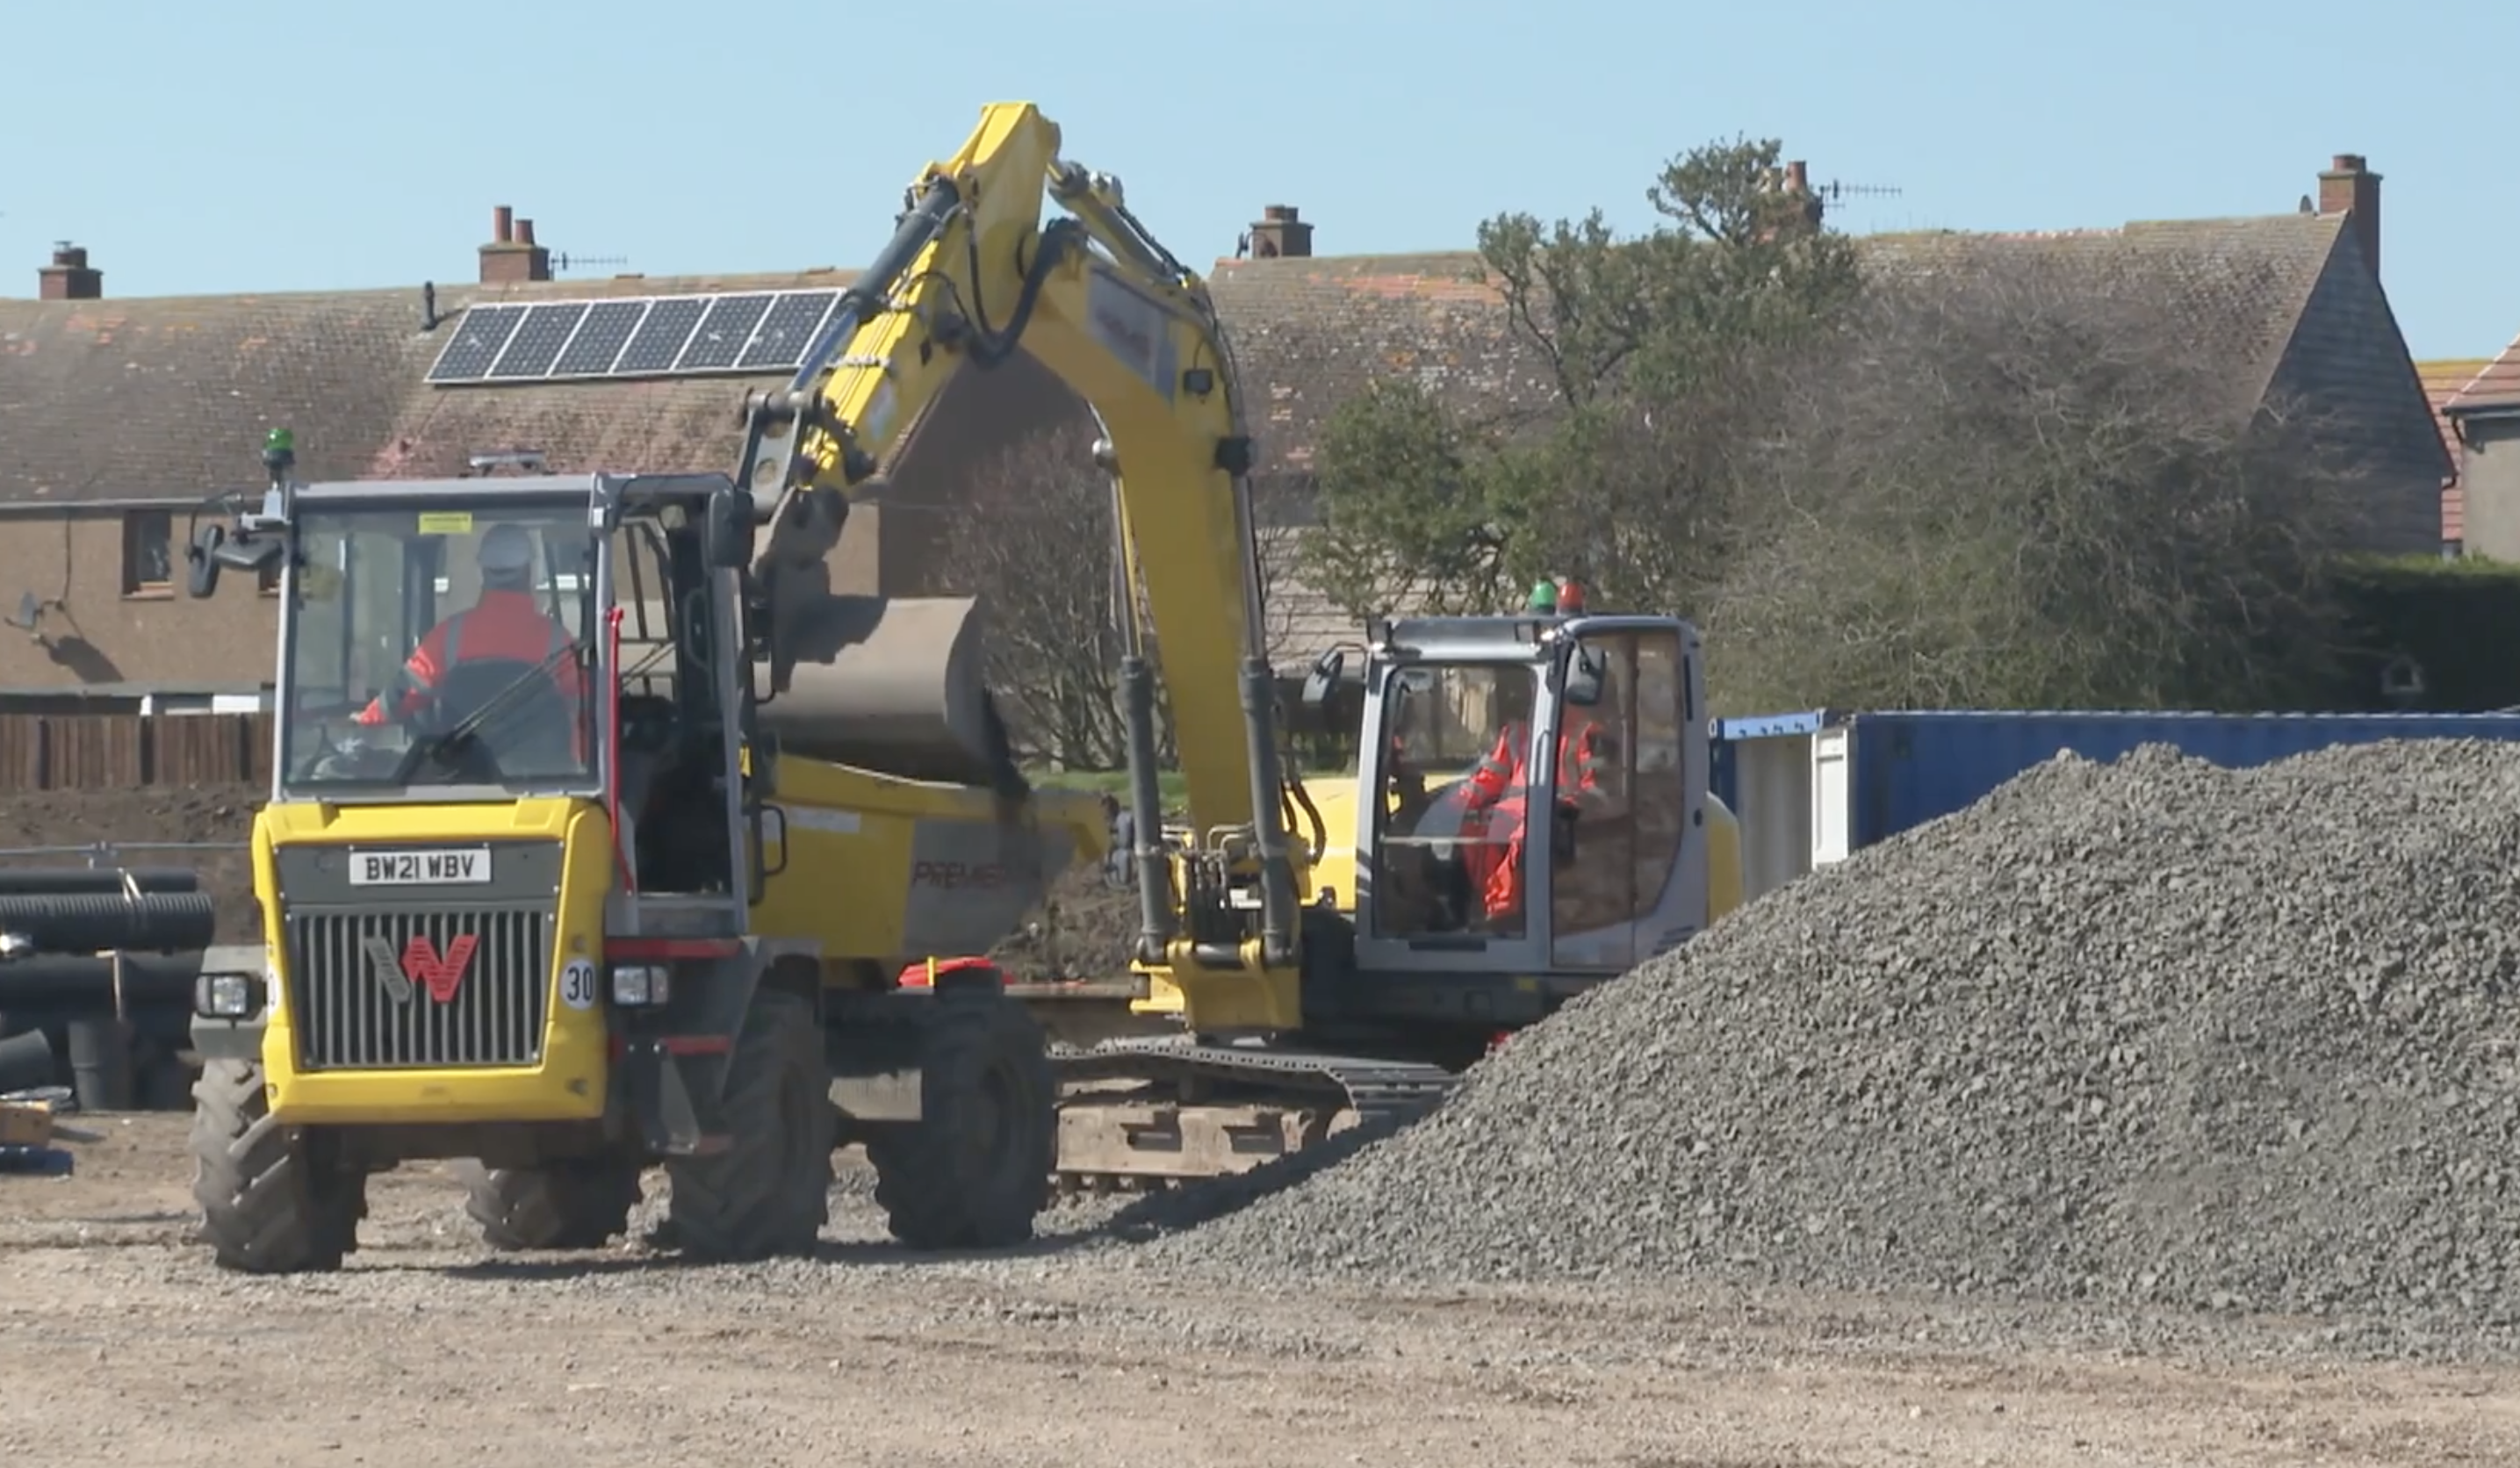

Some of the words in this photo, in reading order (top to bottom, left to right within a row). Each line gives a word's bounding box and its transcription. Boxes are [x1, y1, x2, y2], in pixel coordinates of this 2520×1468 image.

[365, 855, 420, 881] BW21
[428, 853, 475, 878] WBV
[566, 966, 594, 1002] 30
